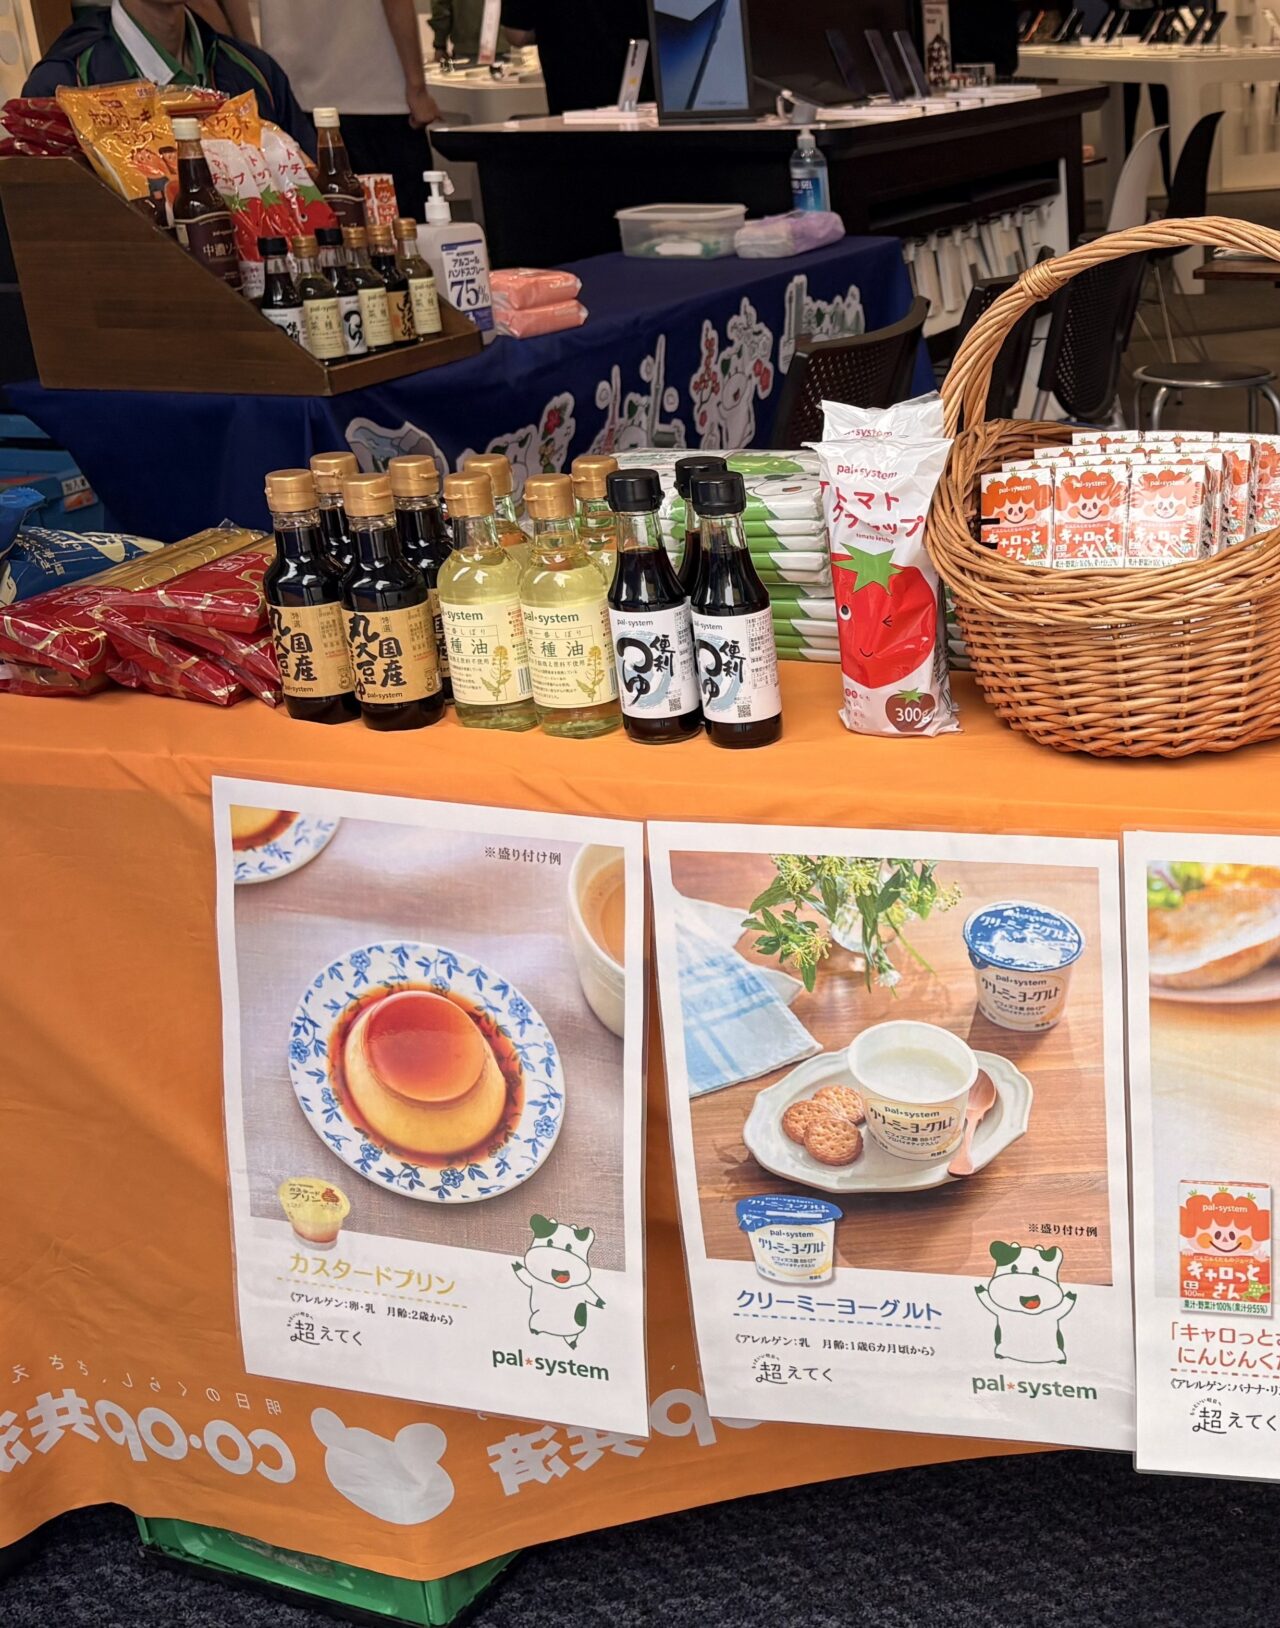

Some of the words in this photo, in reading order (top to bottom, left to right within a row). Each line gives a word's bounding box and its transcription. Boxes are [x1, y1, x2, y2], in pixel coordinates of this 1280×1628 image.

[448, 266, 484, 279] ハンドスプレー
[452, 256, 480, 268] アルコール
[835, 486, 900, 511] トマト
[290, 633, 317, 682] 国産
[349, 613, 381, 685] 丸大豆
[379, 637, 407, 688] 国産
[650, 633, 676, 678] 便利
[719, 639, 746, 684] 便利
[616, 637, 654, 707] つゆ
[695, 638, 723, 708] つゆ
[981, 977, 1060, 1003] クリーミーヨーグルト
[870, 1106, 955, 1134] クリーミーヨーグルト
[758, 1237, 827, 1255] クリーミーヨーグルト
[289, 1252, 455, 1295] カスタードプリン
[1187, 1260, 1260, 1282] キャロっと
[1212, 1282, 1241, 1299] さん
[736, 1289, 942, 1321] クリーミーヨーグルト
[289, 1319, 362, 1346] 超えてく
[755, 1361, 834, 1385] 超えてく
[1192, 1406, 1277, 1435] 超えてく
